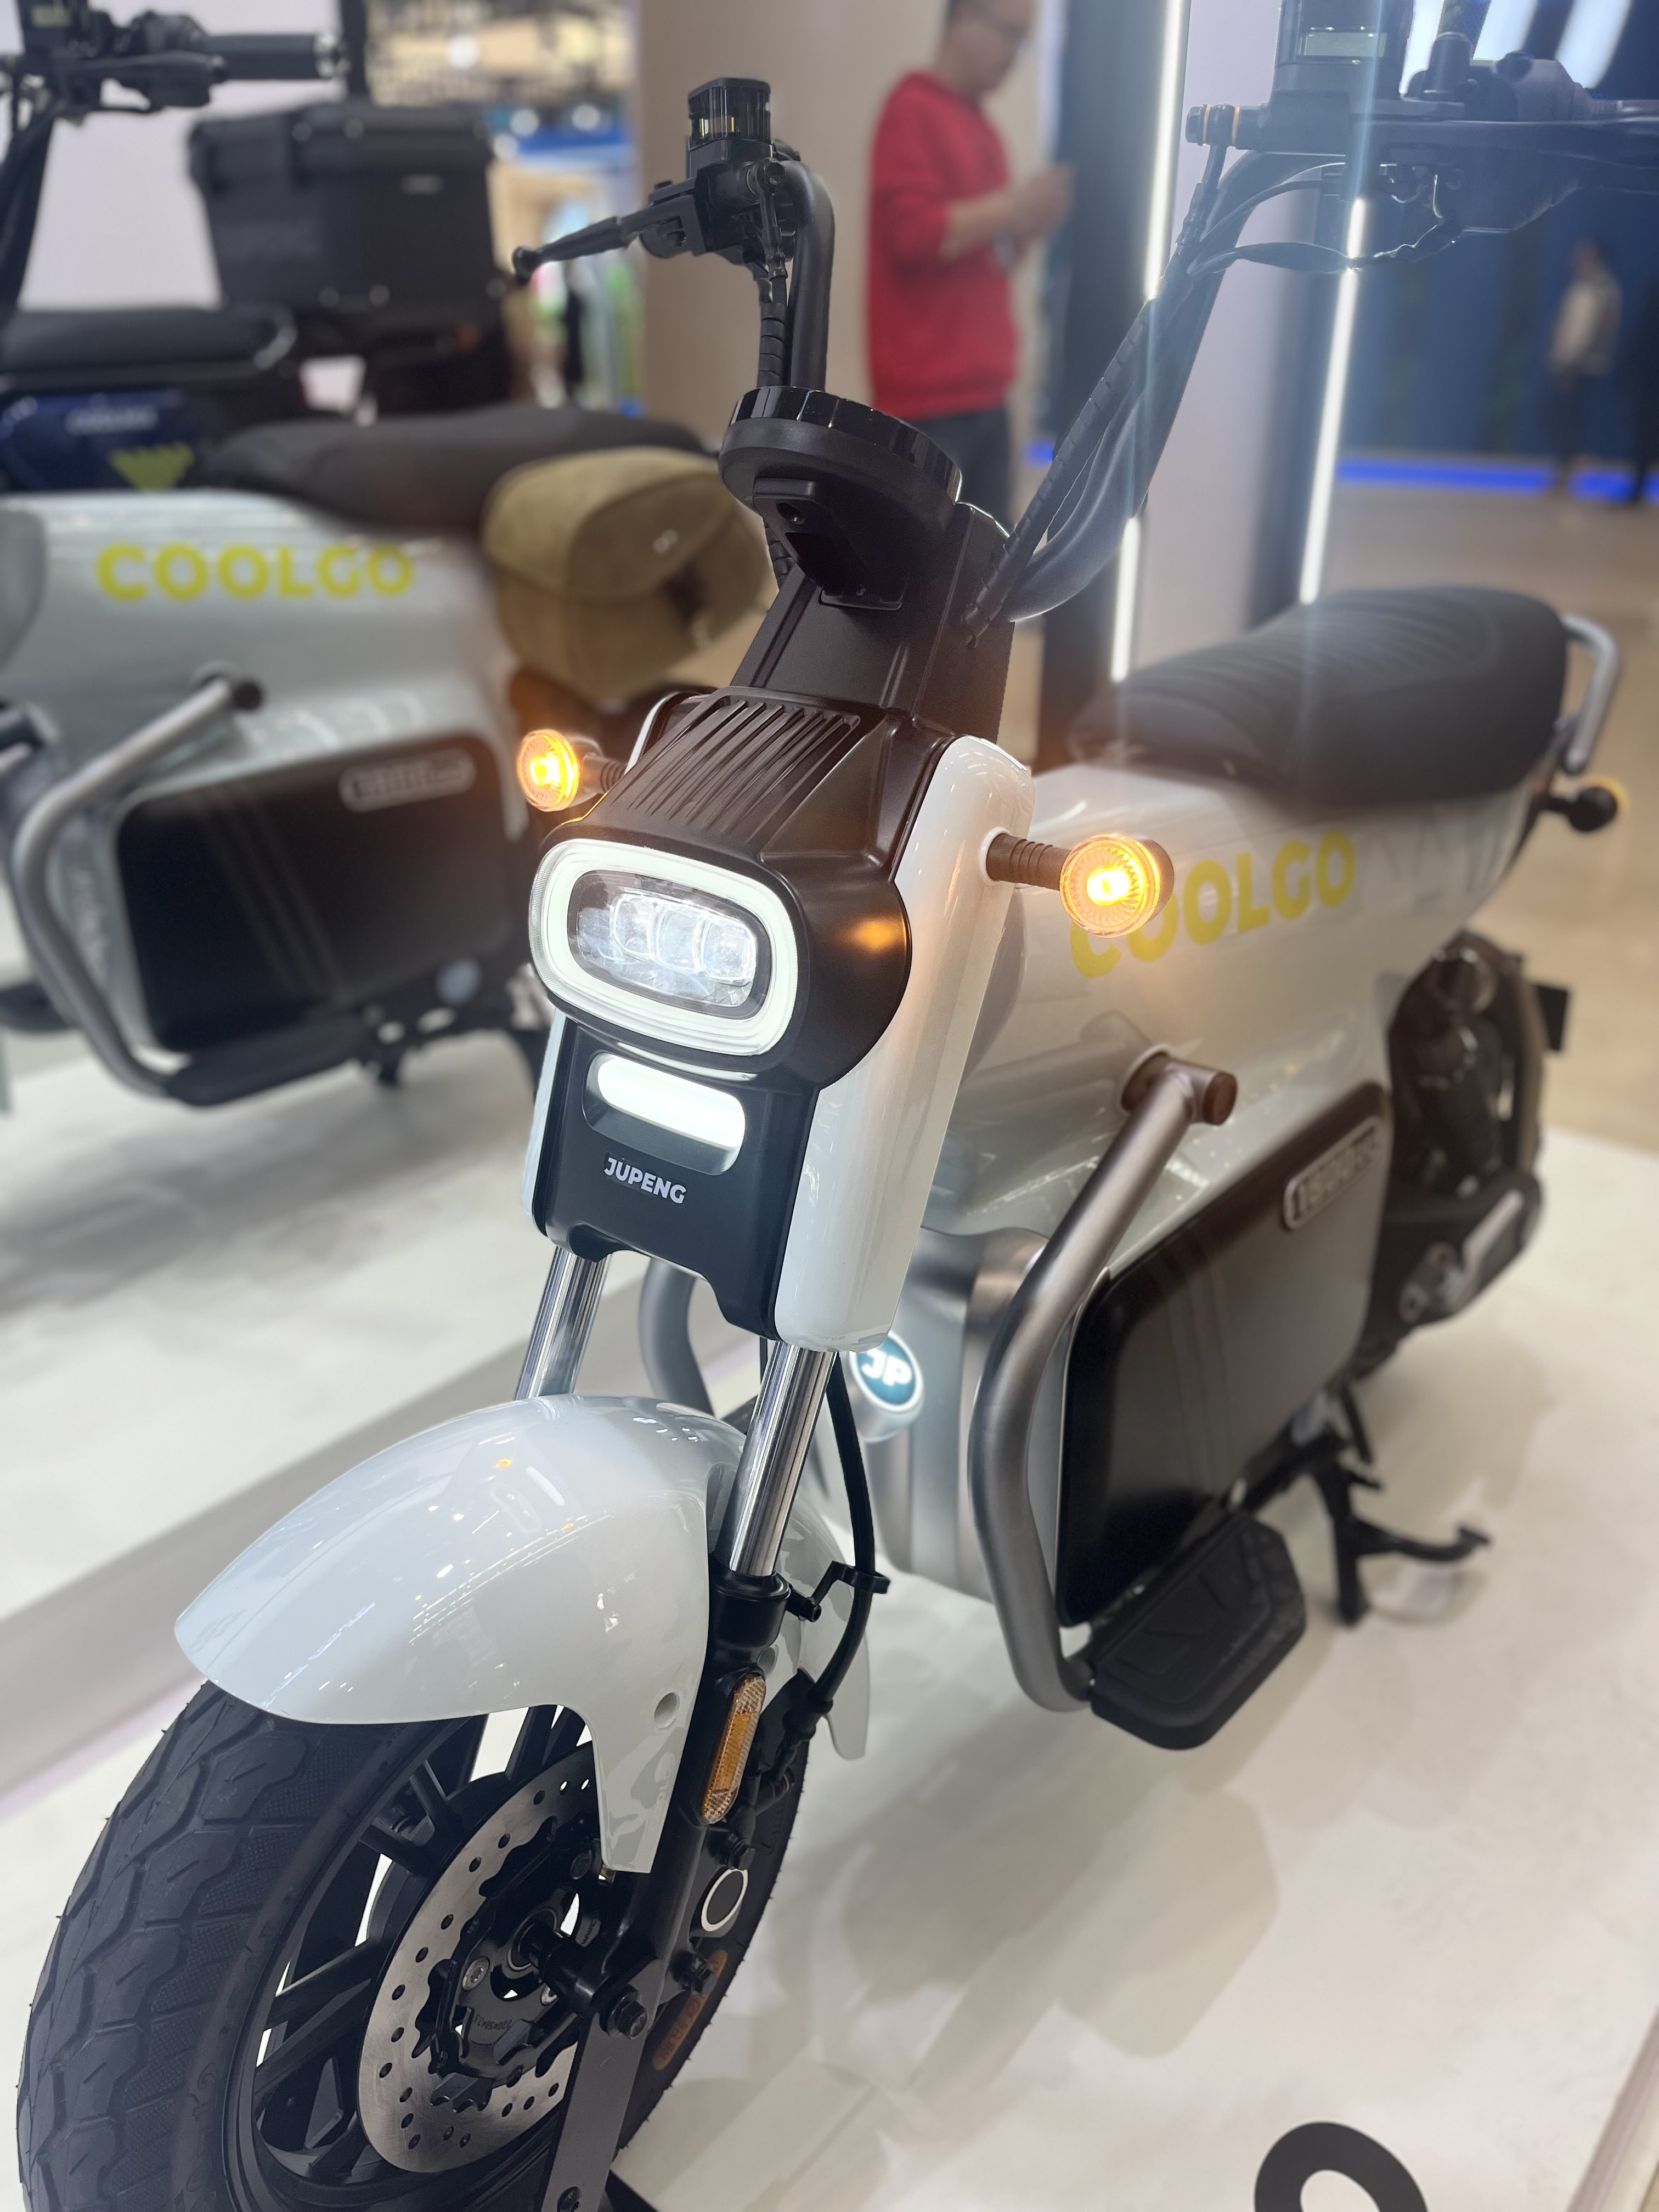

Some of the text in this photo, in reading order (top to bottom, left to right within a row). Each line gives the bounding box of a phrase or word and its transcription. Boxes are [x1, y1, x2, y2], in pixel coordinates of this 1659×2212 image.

[97, 544, 413, 599] COOLGO
[604, 1157, 686, 1204] JUPENG
[861, 1349, 913, 1386] JP
